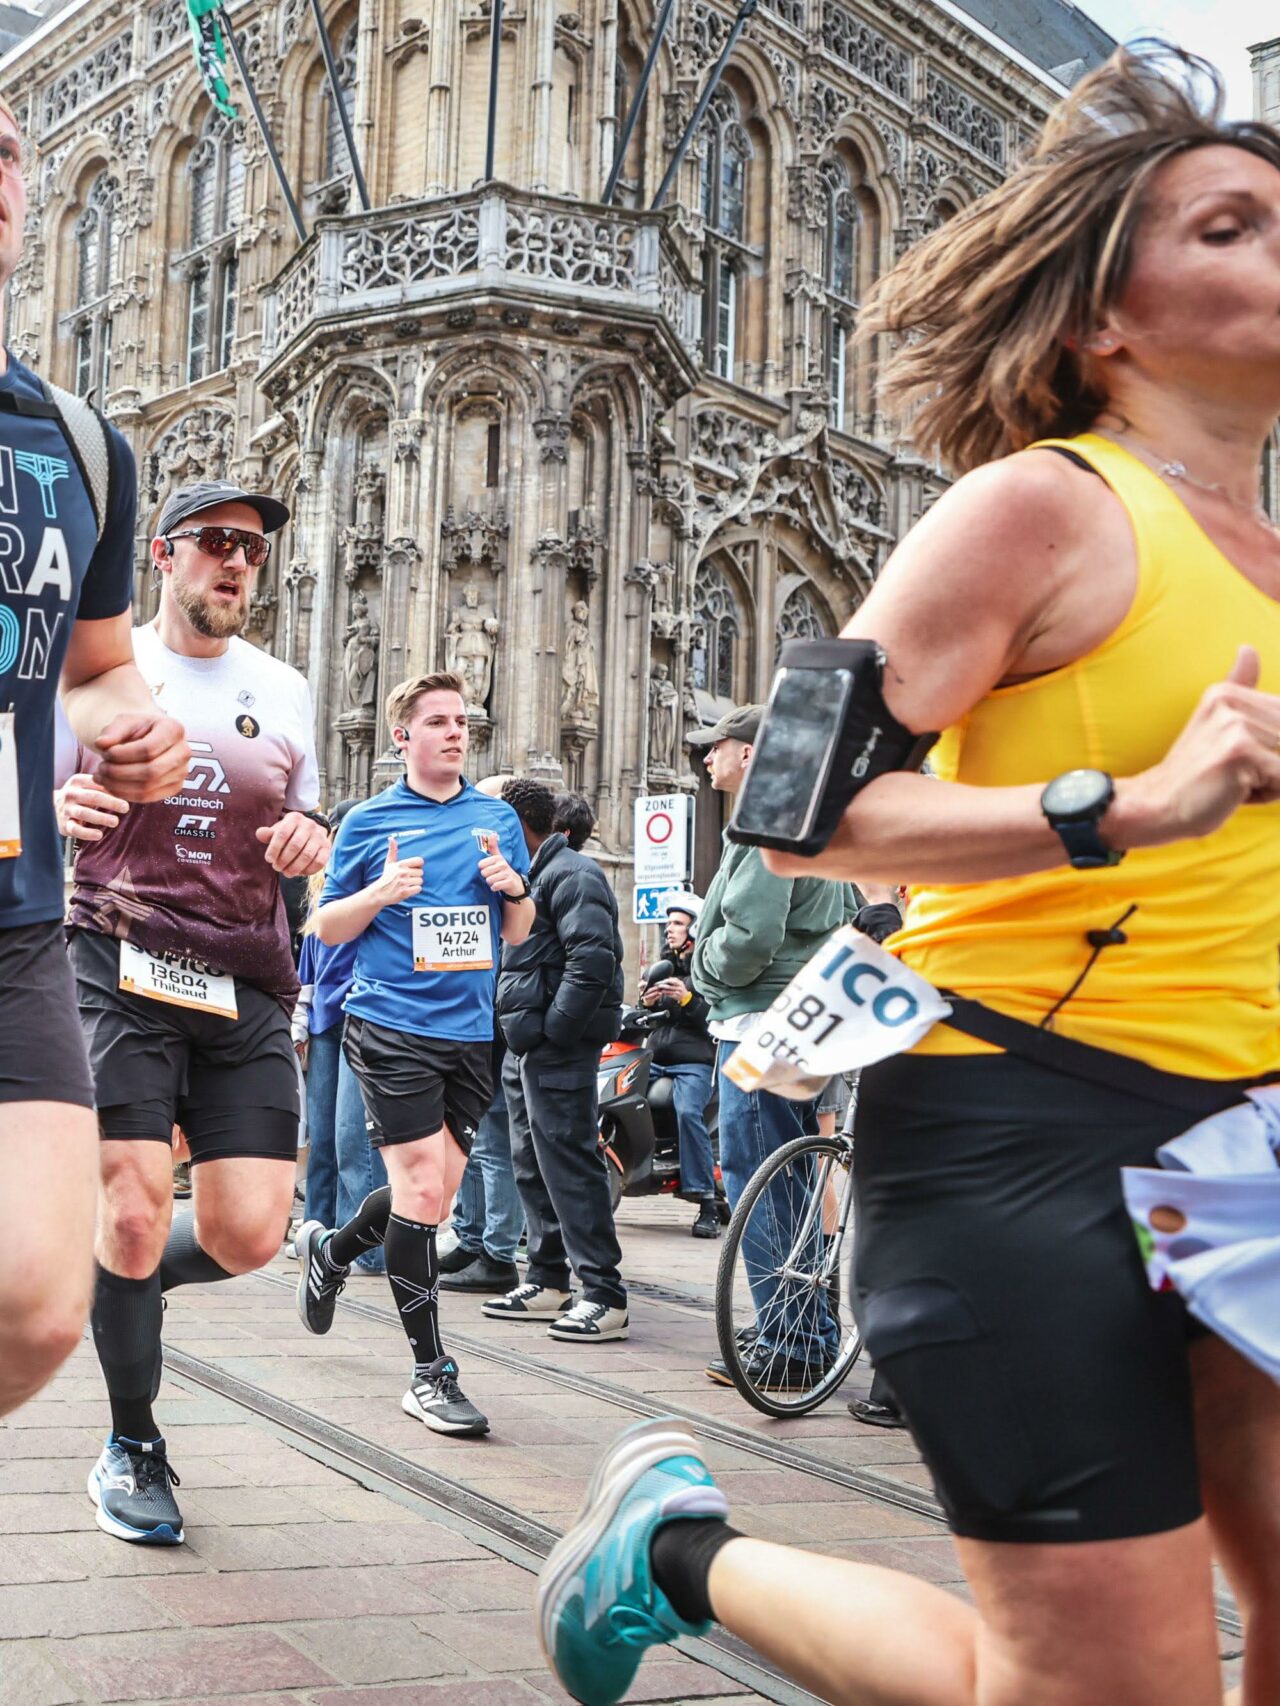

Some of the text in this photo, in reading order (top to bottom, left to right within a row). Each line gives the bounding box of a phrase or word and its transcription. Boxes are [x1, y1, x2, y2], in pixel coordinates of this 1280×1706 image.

[163, 794, 224, 811] sainatech
[645, 799, 674, 812] ZONE
[177, 814, 218, 831] FT
[174, 828, 216, 839] CHASSIS
[188, 851, 213, 861] MOVI
[419, 910, 487, 928] SOFICO
[436, 931, 479, 945] 14724
[441, 946, 477, 958] Arthur
[149, 962, 208, 991] 13604
[151, 976, 207, 1001] Thibaud
[821, 946, 919, 1028] ICO
